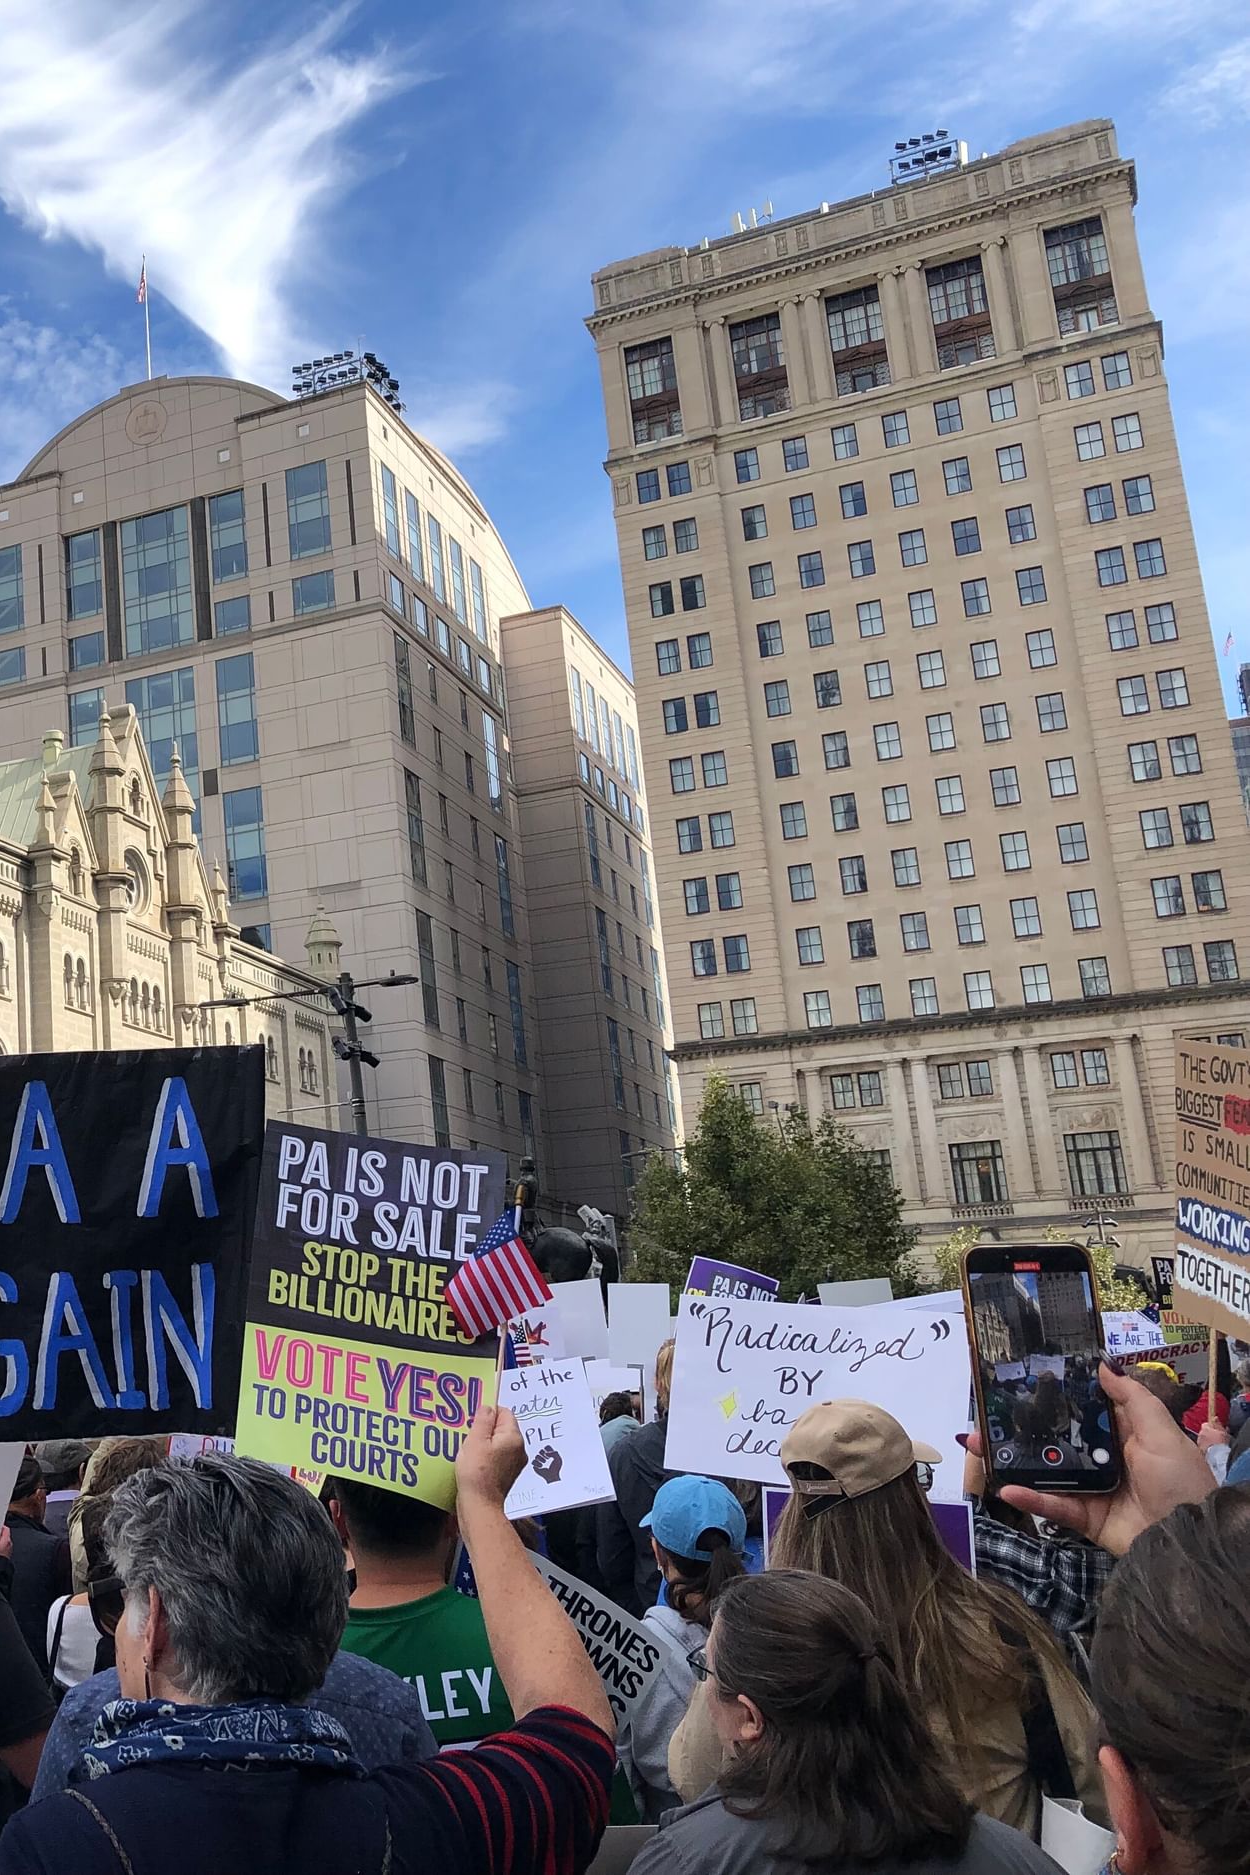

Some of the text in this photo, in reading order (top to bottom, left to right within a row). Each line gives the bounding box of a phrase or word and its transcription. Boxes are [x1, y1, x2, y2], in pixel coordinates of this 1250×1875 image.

[1179, 1052, 1250, 1089] THE GOVT'
[1175, 1086, 1224, 1121] BIGGEST
[137, 1076, 219, 1218] A
[1183, 1128, 1250, 1172] IS SMALL
[277, 1134, 488, 1212] PA IS NOT
[1175, 1161, 1250, 1209] COMMUNITIE
[275, 1184, 482, 1262] FOR SALE
[1177, 1199, 1250, 1253] WORKING
[301, 1241, 448, 1302] STOP THE
[712, 1274, 730, 1294] PA
[732, 1280, 749, 1298] IS
[1155, 1260, 1173, 1273] PA
[1159, 1272, 1174, 1285] FO
[1177, 1249, 1250, 1315] TOGETHER
[1116, 1341, 1210, 1367] DEMOCRACY
[1124, 1331, 1145, 1346] ARE
[254, 1329, 483, 1429] VOTE YES!
[510, 1368, 575, 1392] of the
[773, 1366, 824, 1397] BY
[252, 1383, 468, 1462] TO PROTECT OU
[512, 1394, 563, 1416] eater
[741, 1398, 797, 1425] ba
[526, 1421, 564, 1446] PLE
[310, 1431, 420, 1487] COURTS
[547, 1574, 660, 1673] THRONES
[403, 1666, 493, 1721] LEY
